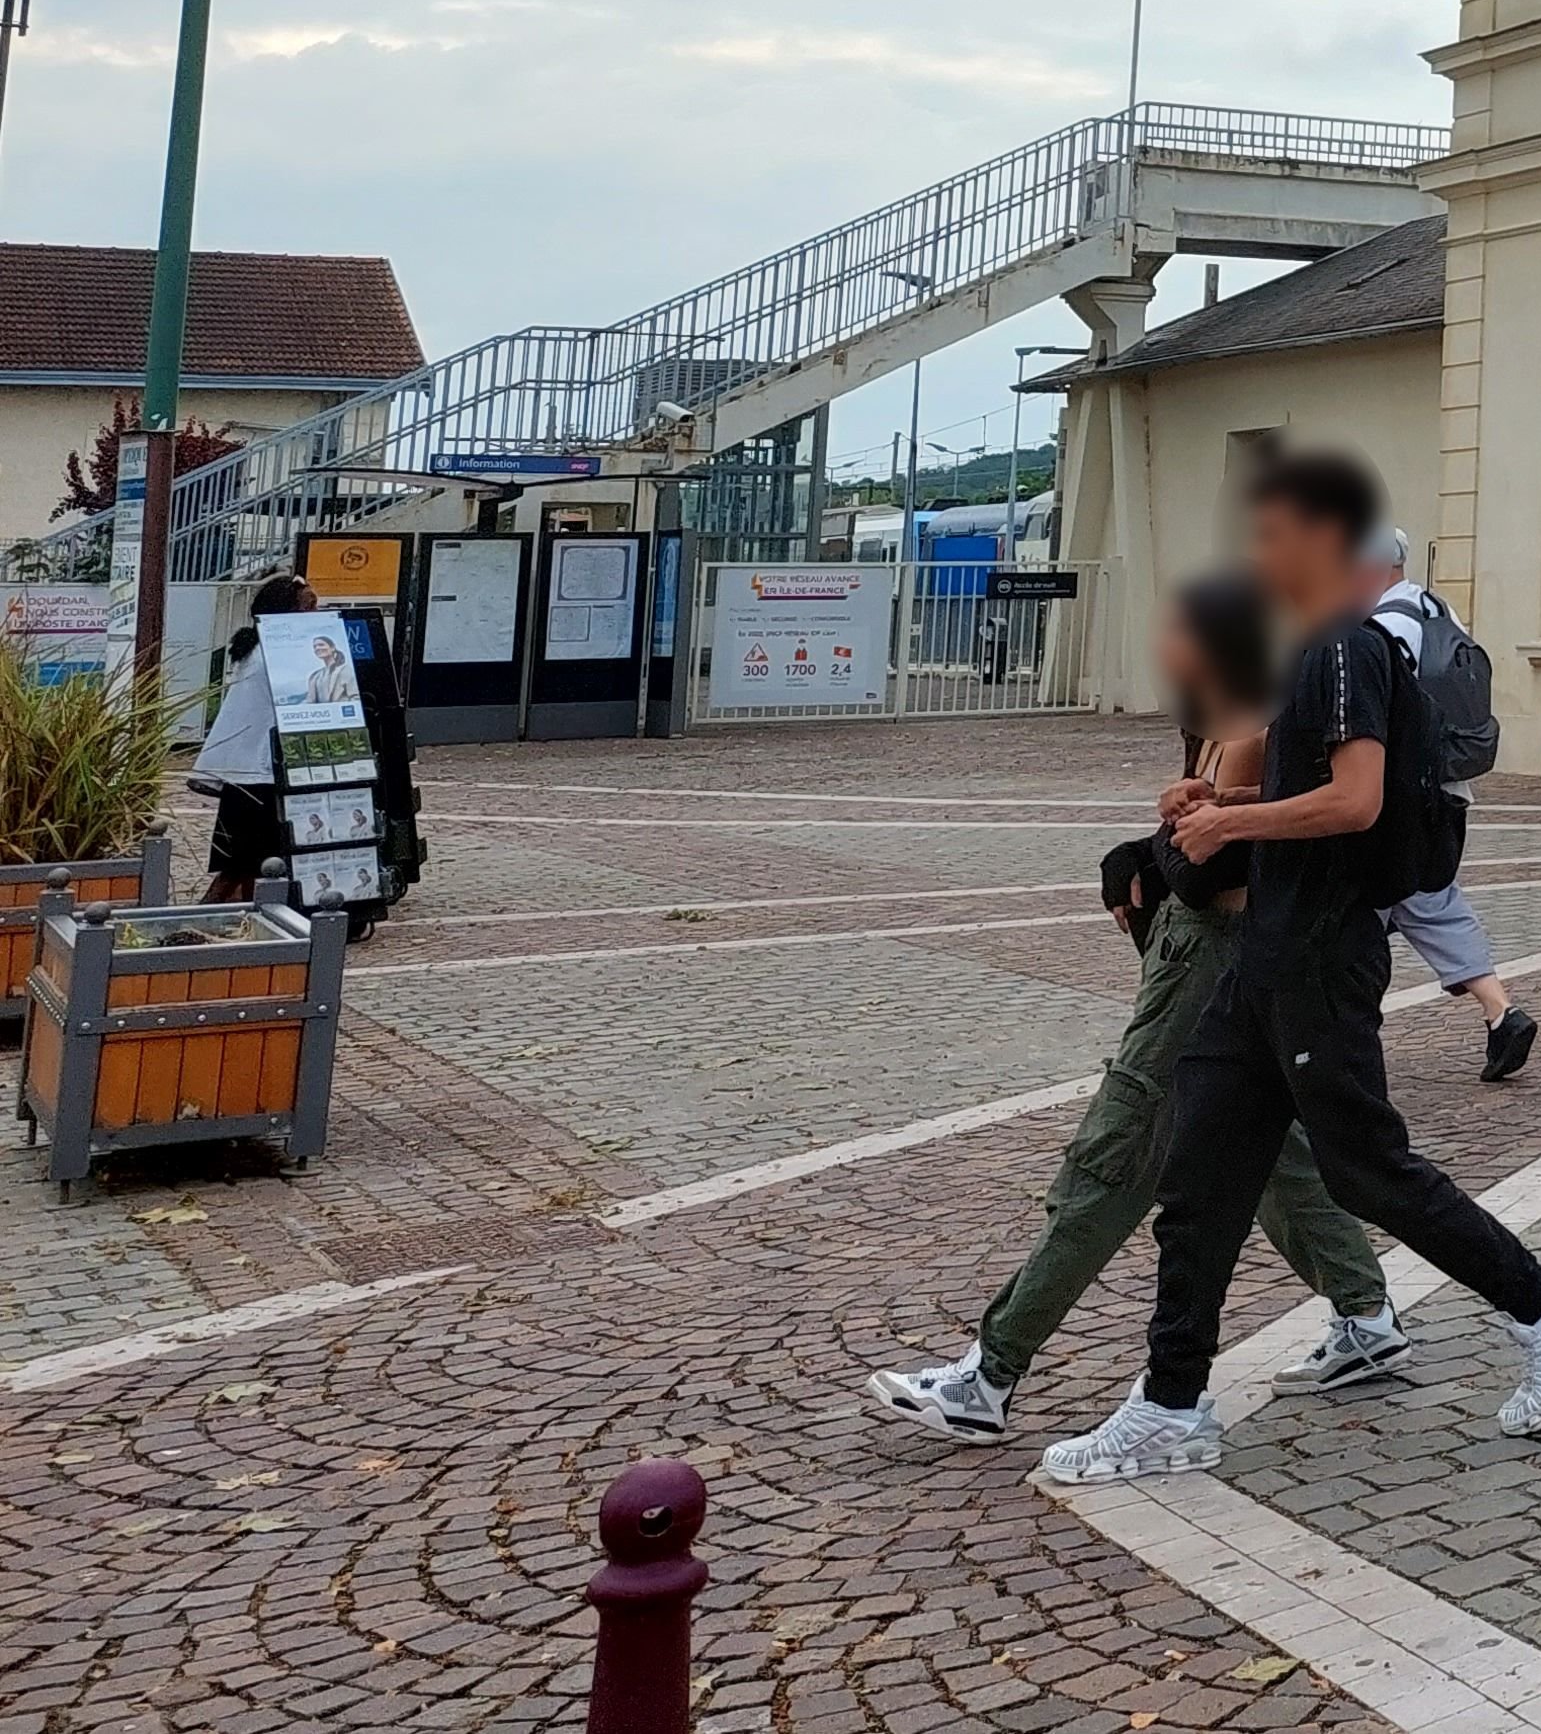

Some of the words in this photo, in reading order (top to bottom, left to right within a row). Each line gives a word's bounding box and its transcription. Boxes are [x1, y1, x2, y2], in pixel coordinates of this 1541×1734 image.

[459, 458, 520, 469] Information
[825, 575, 860, 583] AVANCE
[743, 664, 768, 676] 300
[784, 664, 816, 676] 1700
[830, 663, 851, 676] 2,4
